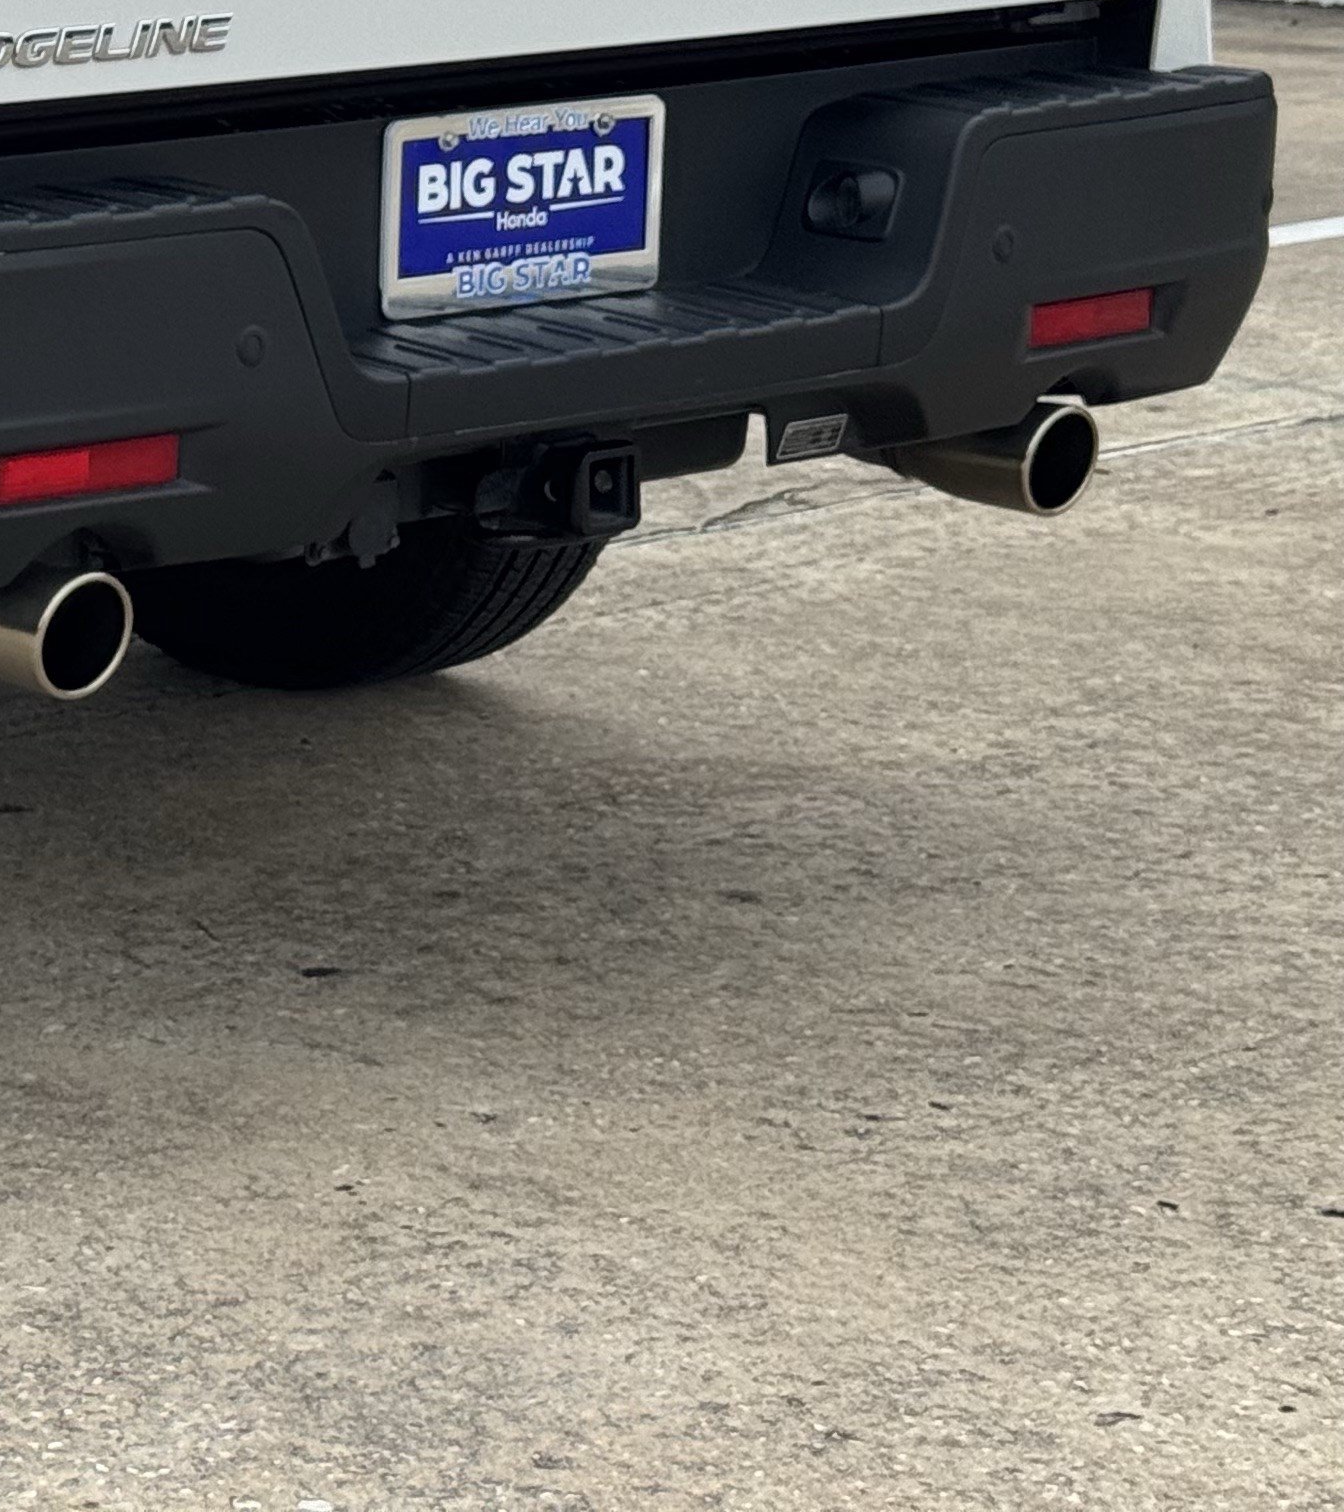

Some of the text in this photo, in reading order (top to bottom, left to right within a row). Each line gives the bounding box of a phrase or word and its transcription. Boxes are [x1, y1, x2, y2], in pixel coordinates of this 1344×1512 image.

[467, 106, 590, 138] We Hear You
[417, 144, 625, 214] BIG STAR
[496, 206, 549, 231] Honda
[456, 253, 592, 298] BIG STAR
